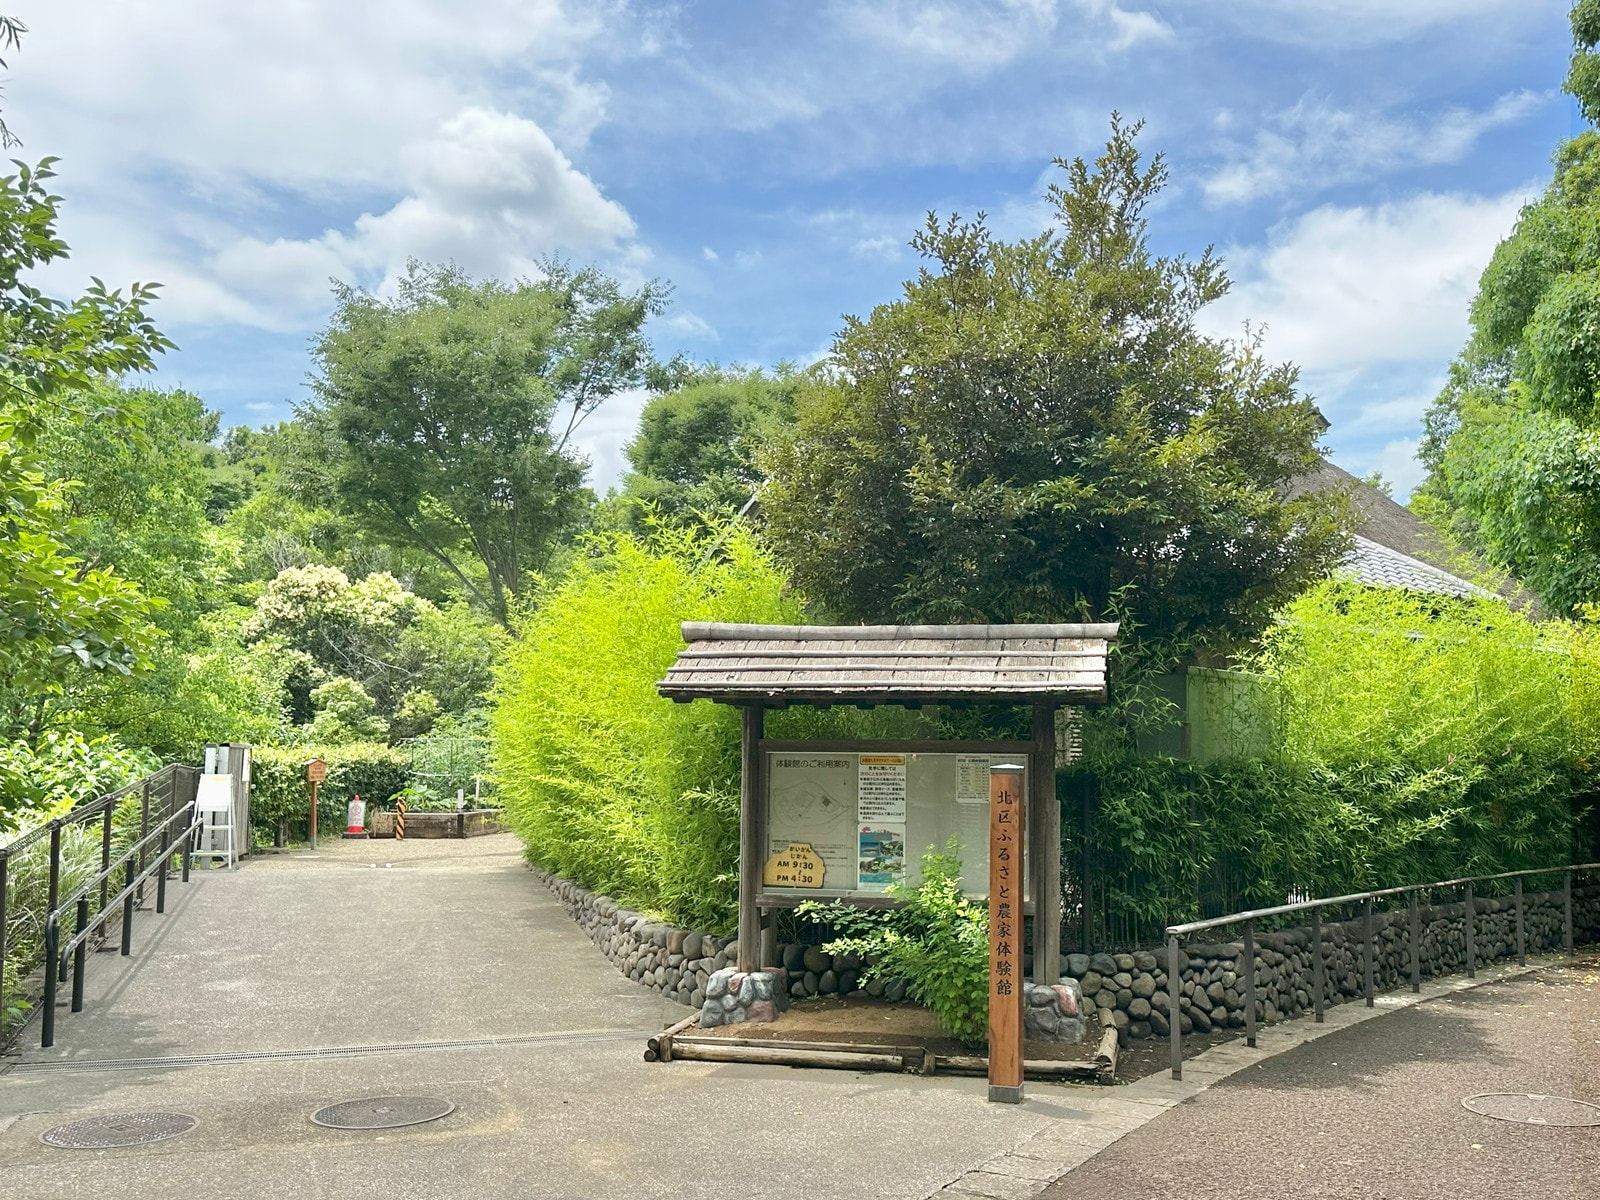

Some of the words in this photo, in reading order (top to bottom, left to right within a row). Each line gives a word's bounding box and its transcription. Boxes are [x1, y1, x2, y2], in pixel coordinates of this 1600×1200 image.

[775, 759, 850, 769] 体験館のご利用案内
[792, 861, 814, 870] 9:30
[790, 875, 813, 883] 4:30
[995, 790, 1013, 996] 北区ふるさと農家体験館
